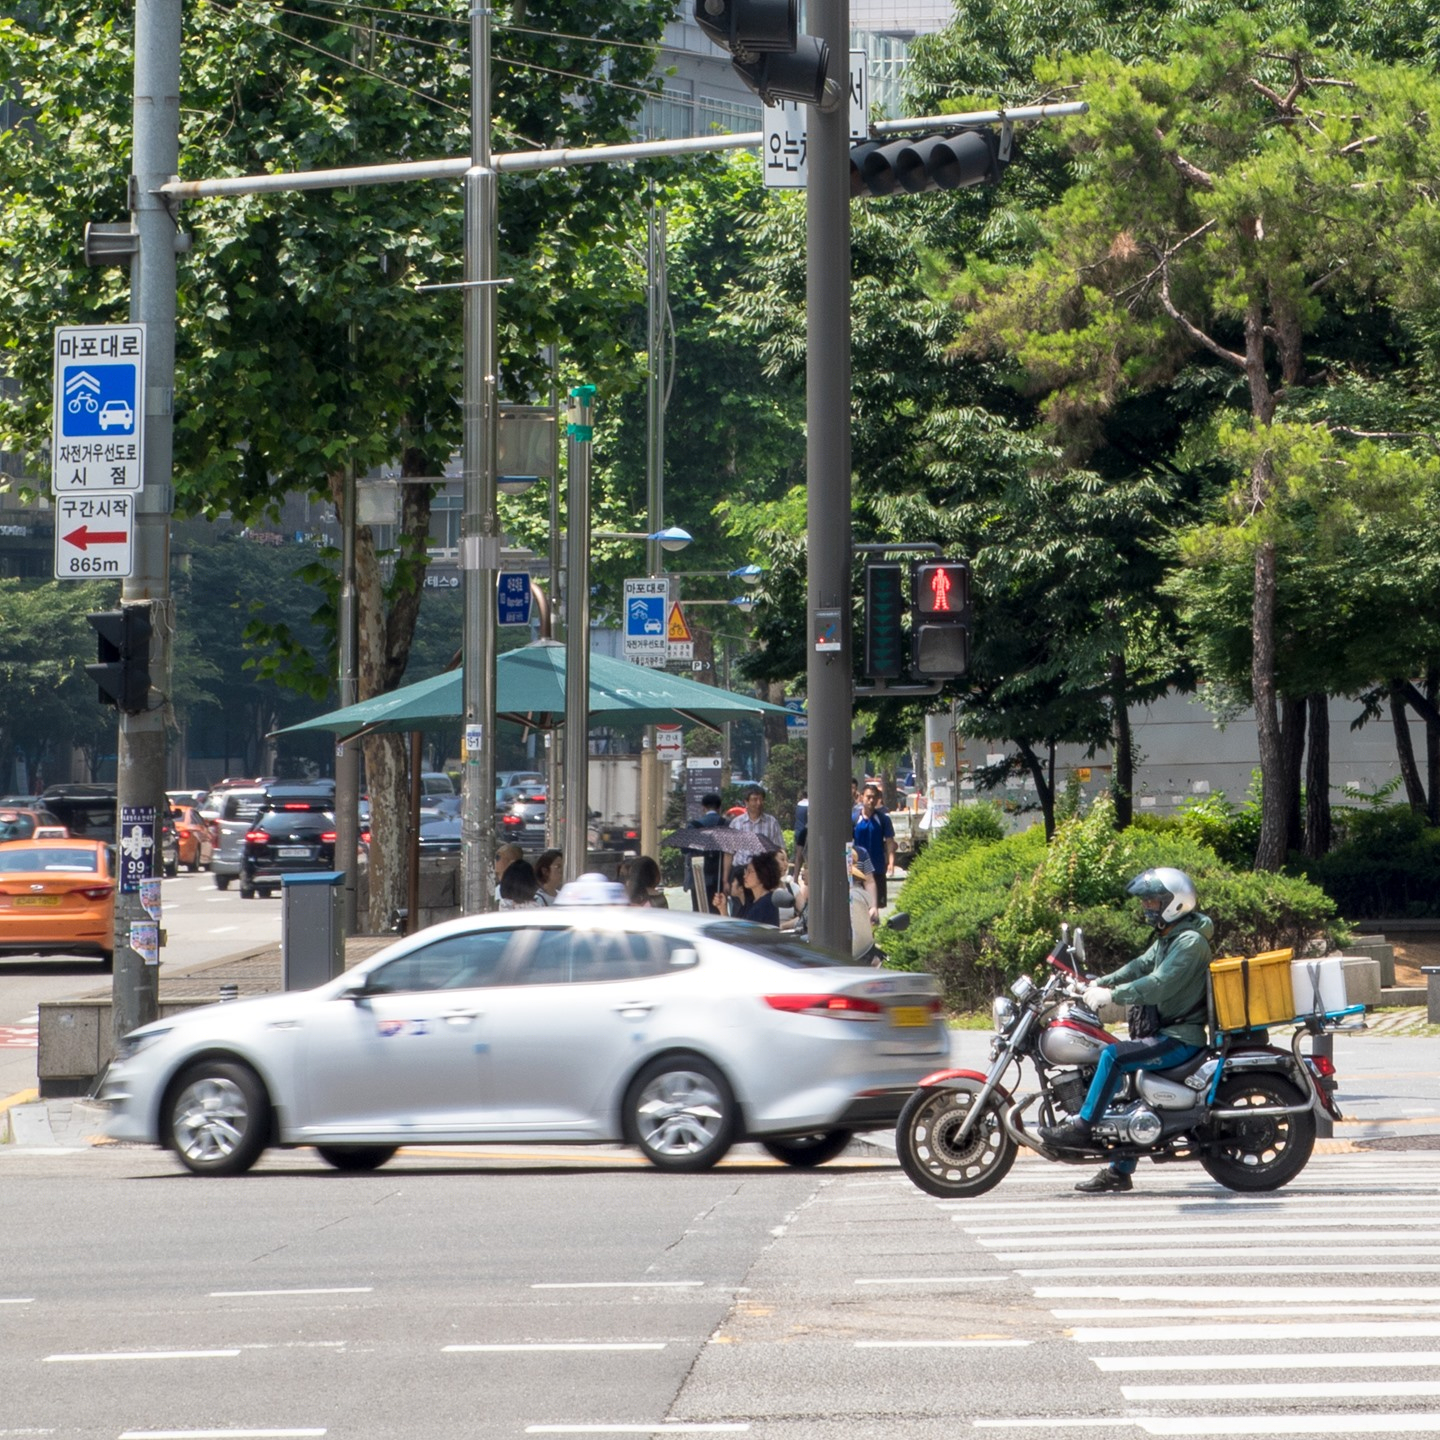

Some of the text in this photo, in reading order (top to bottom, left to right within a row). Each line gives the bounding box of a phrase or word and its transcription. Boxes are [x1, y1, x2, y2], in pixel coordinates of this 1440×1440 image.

[60, 335, 140, 358] 마포대로
[59, 444, 137, 463] 자전거우선도로
[62, 500, 128, 518] 구간시작
[70, 557, 119, 572] 865m
[626, 583, 666, 594] 마포대로
[128, 861, 145, 874] 99
